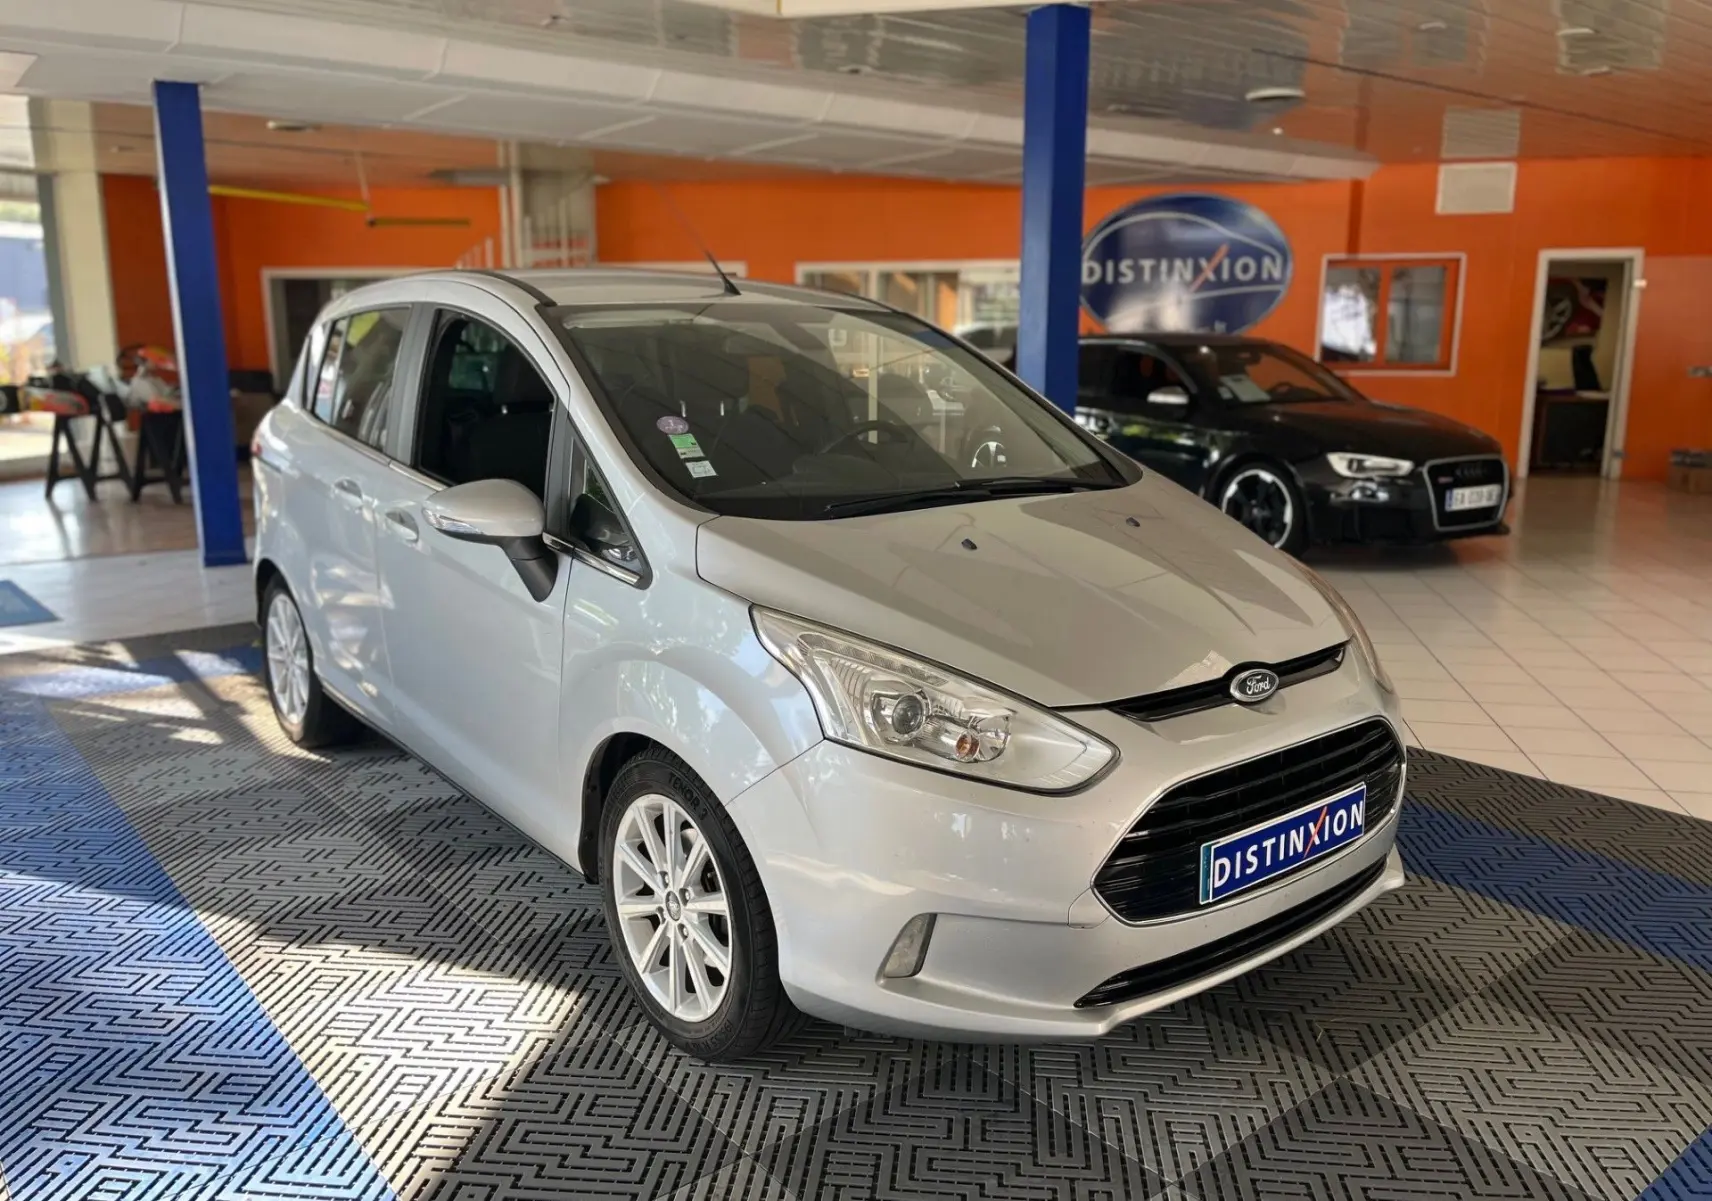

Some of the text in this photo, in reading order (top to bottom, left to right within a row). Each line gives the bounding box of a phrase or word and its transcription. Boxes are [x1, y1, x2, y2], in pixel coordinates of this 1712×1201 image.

[1081, 247, 1282, 289] DISTINXION
[1246, 675, 1270, 695] Ford
[1213, 800, 1364, 888] DISTINXION
